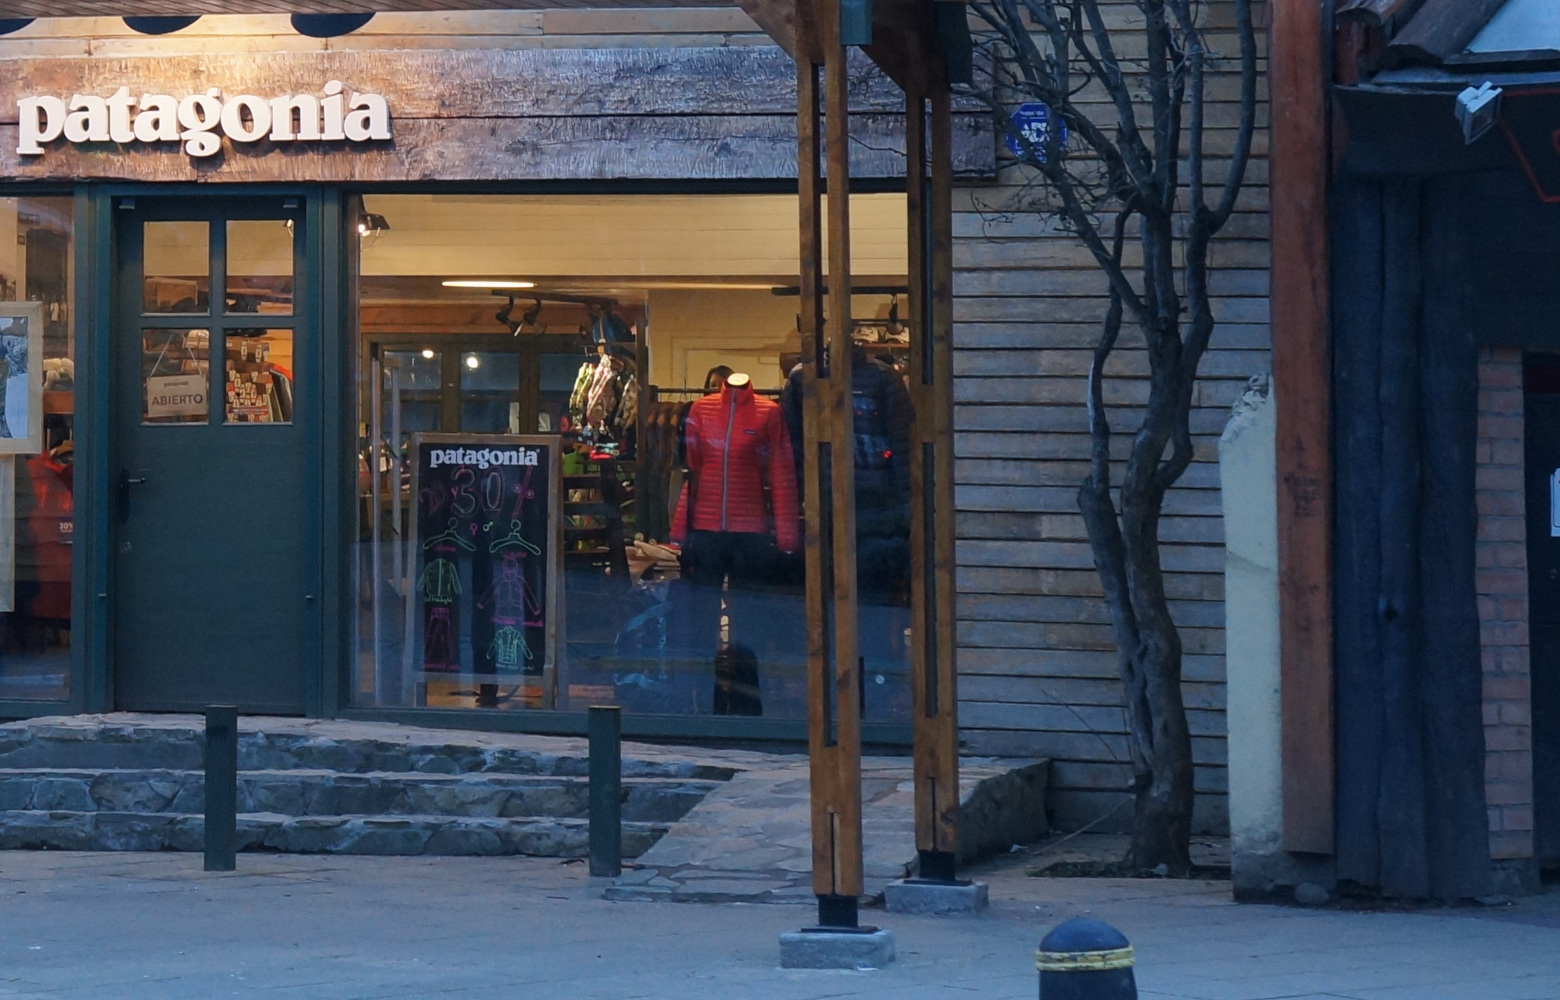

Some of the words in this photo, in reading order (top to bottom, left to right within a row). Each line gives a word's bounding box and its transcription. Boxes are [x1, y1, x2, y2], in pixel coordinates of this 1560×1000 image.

[17, 81, 392, 157] patagonia
[151, 394, 203, 406] ABIERTO
[430, 447, 538, 469] patagonia
